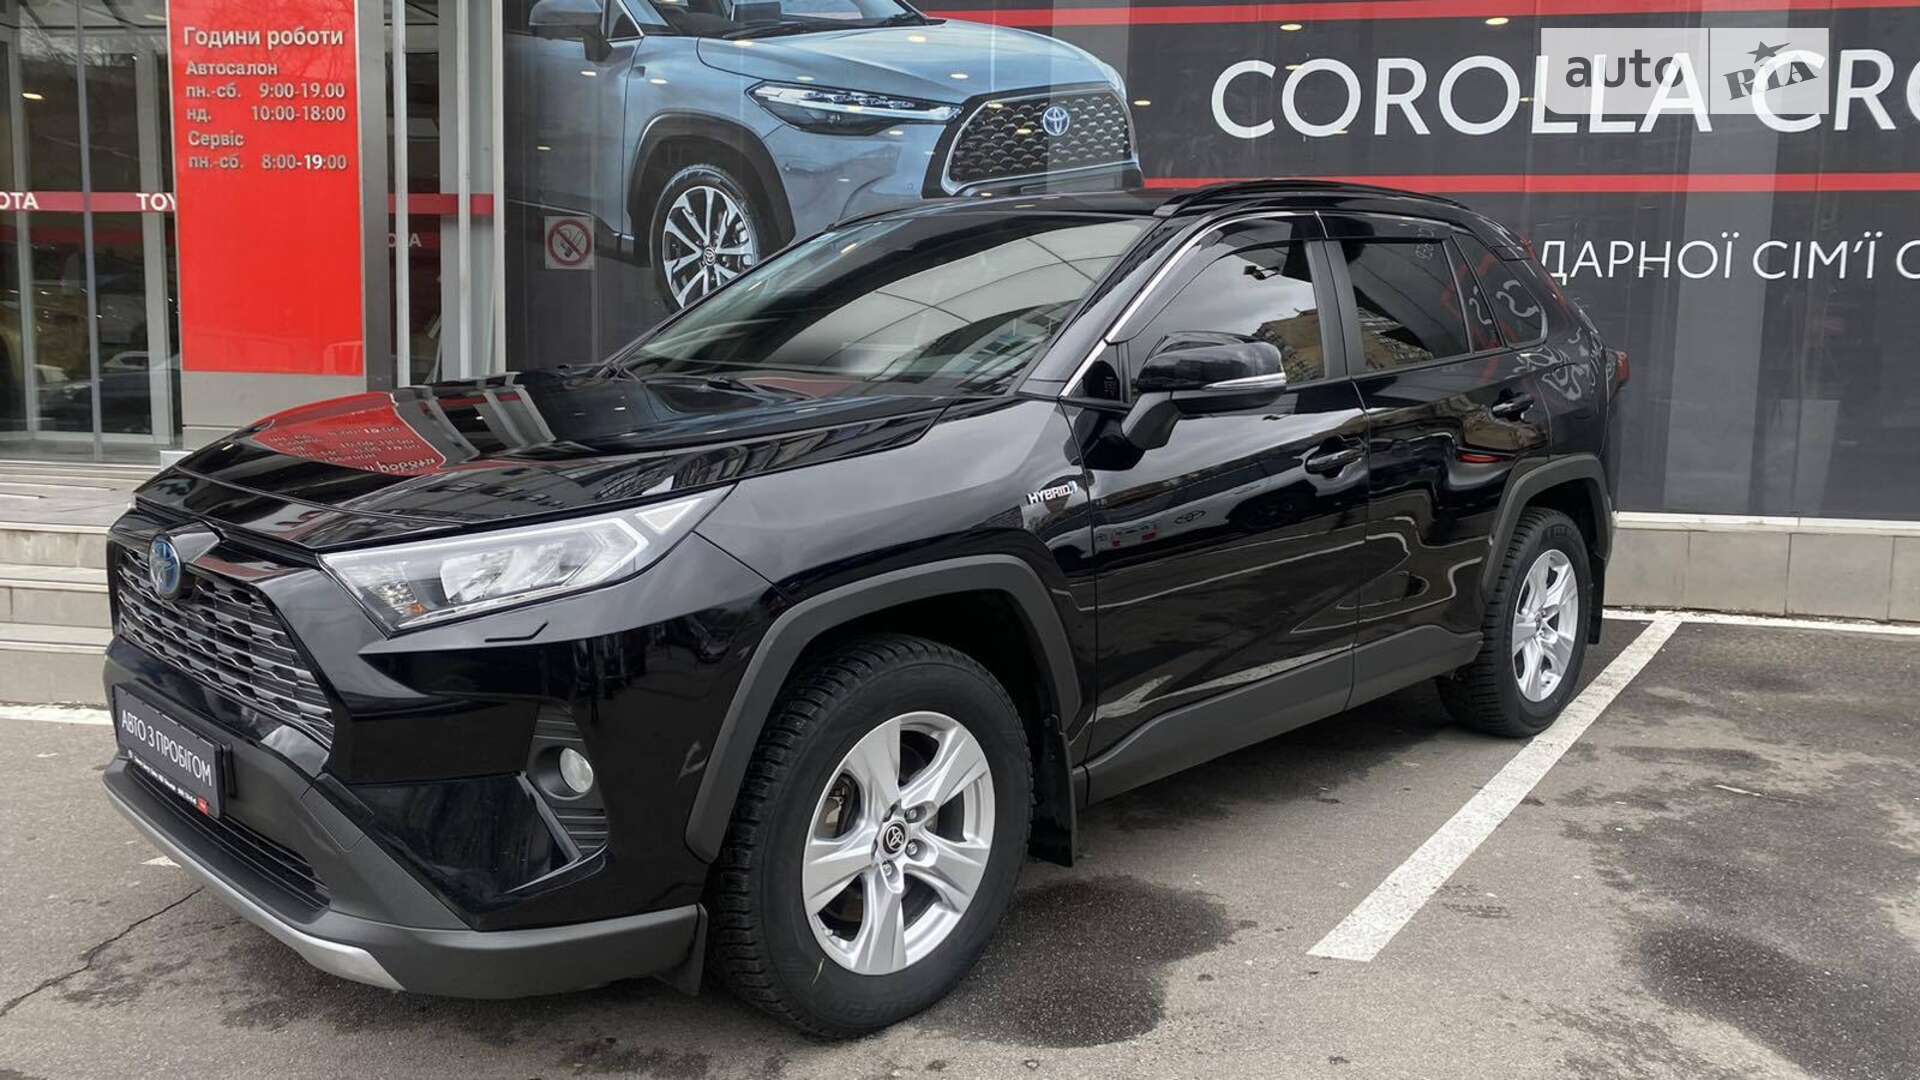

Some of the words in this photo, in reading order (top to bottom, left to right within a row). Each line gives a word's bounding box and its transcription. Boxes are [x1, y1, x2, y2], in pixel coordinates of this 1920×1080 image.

[183, 26, 261, 48] Години
[267, 25, 344, 50] роботи
[185, 61, 278, 75] Автосалон
[186, 82, 241, 98] пн.-сб.
[259, 83, 345, 98] 9:00-19.00
[1211, 53, 1713, 138] COROLLA
[1750, 49, 1920, 132] CR
[187, 108, 212, 122] нд.
[251, 106, 346, 121] 10:00-18:00
[188, 130, 245, 148] Сервіс
[189, 154, 244, 168] пн.-сб.
[262, 154, 347, 169] 8:00-19:00
[1541, 231, 1740, 285] ДАРНОЇ
[1027, 484, 1070, 504] HYBRID
[122, 709, 146, 741] АВТО
[156, 730, 212, 787] ПРОБІГОМ
